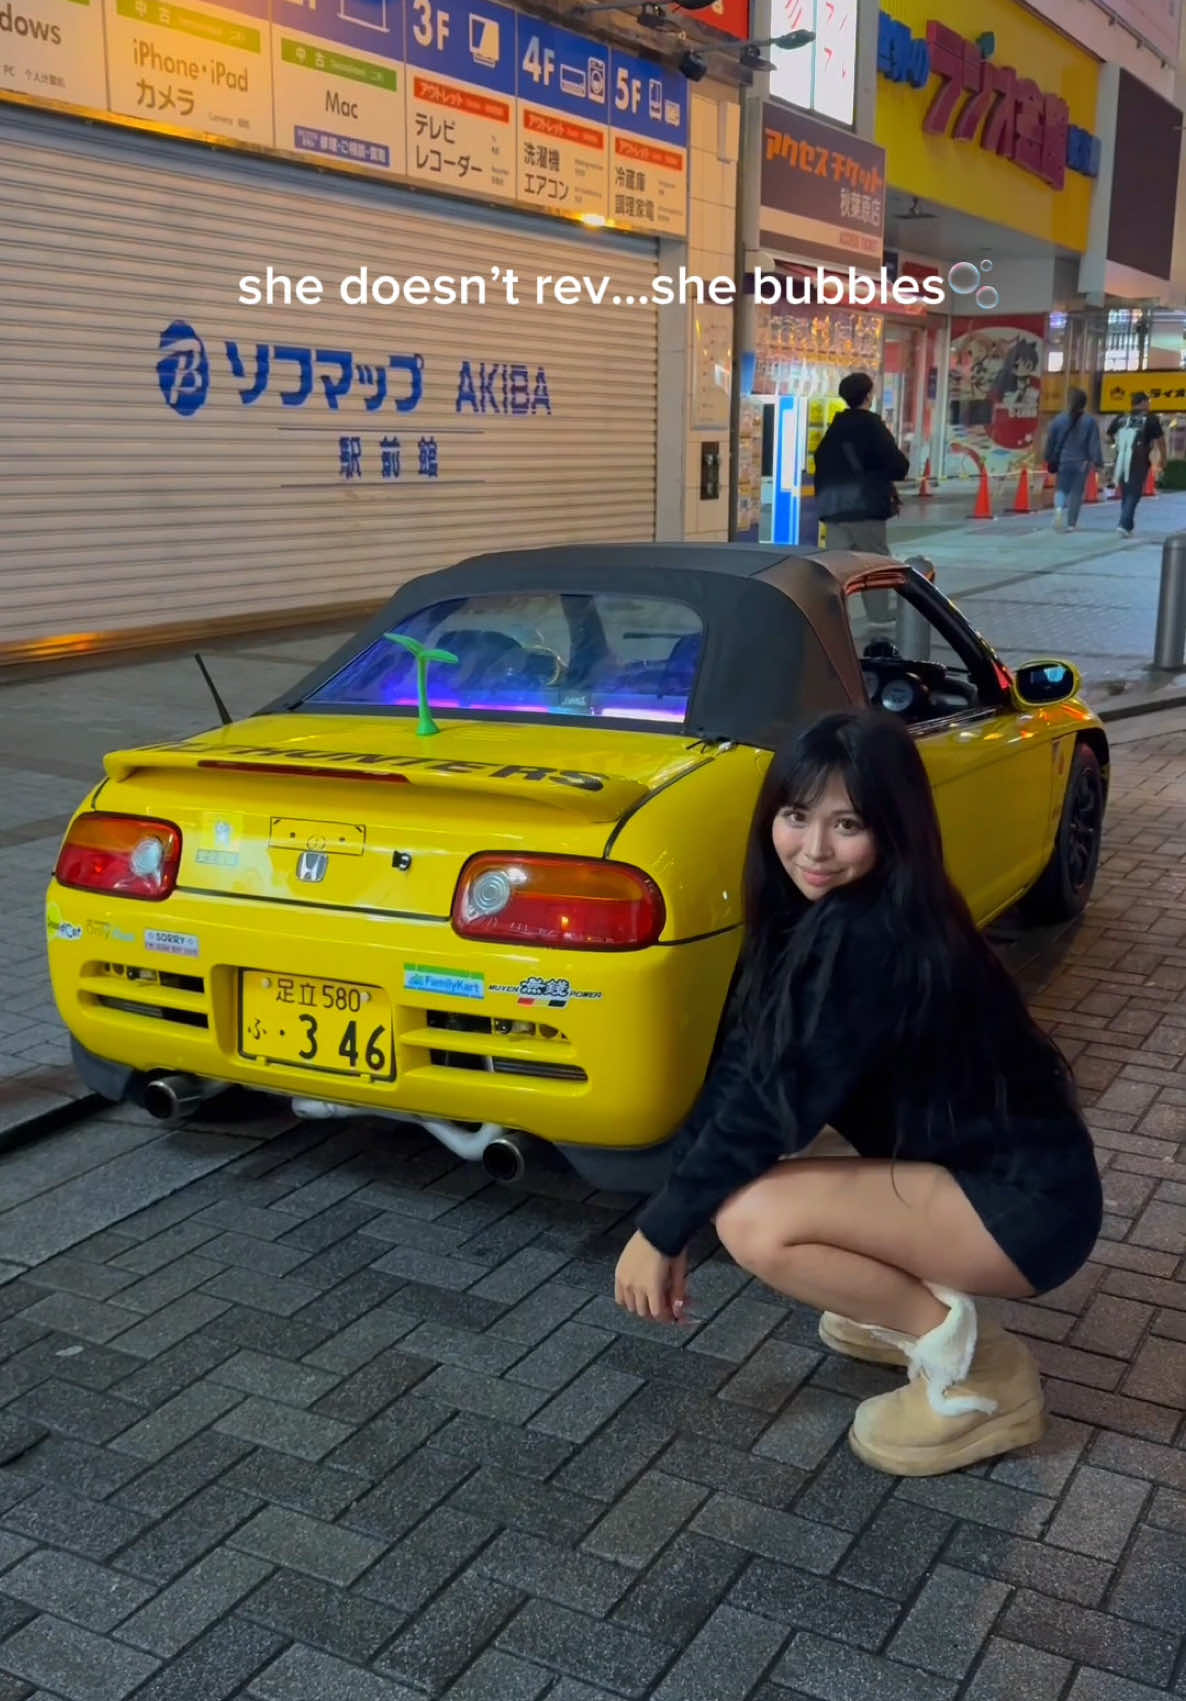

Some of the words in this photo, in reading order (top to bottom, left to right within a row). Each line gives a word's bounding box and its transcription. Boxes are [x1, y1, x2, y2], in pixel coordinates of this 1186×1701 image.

[413, 0, 449, 51] 3F
[522, 35, 555, 86] 4F
[136, 79, 194, 115] カメラ
[325, 90, 358, 119] Mac
[615, 67, 641, 114] 5F
[415, 112, 456, 145] テレビ
[416, 145, 483, 178] レコーダー
[524, 173, 569, 201] エアコン
[225, 340, 425, 413] ソフマップ
[456, 359, 552, 415] AKIBA
[248, 1018, 267, 1041] ふ
